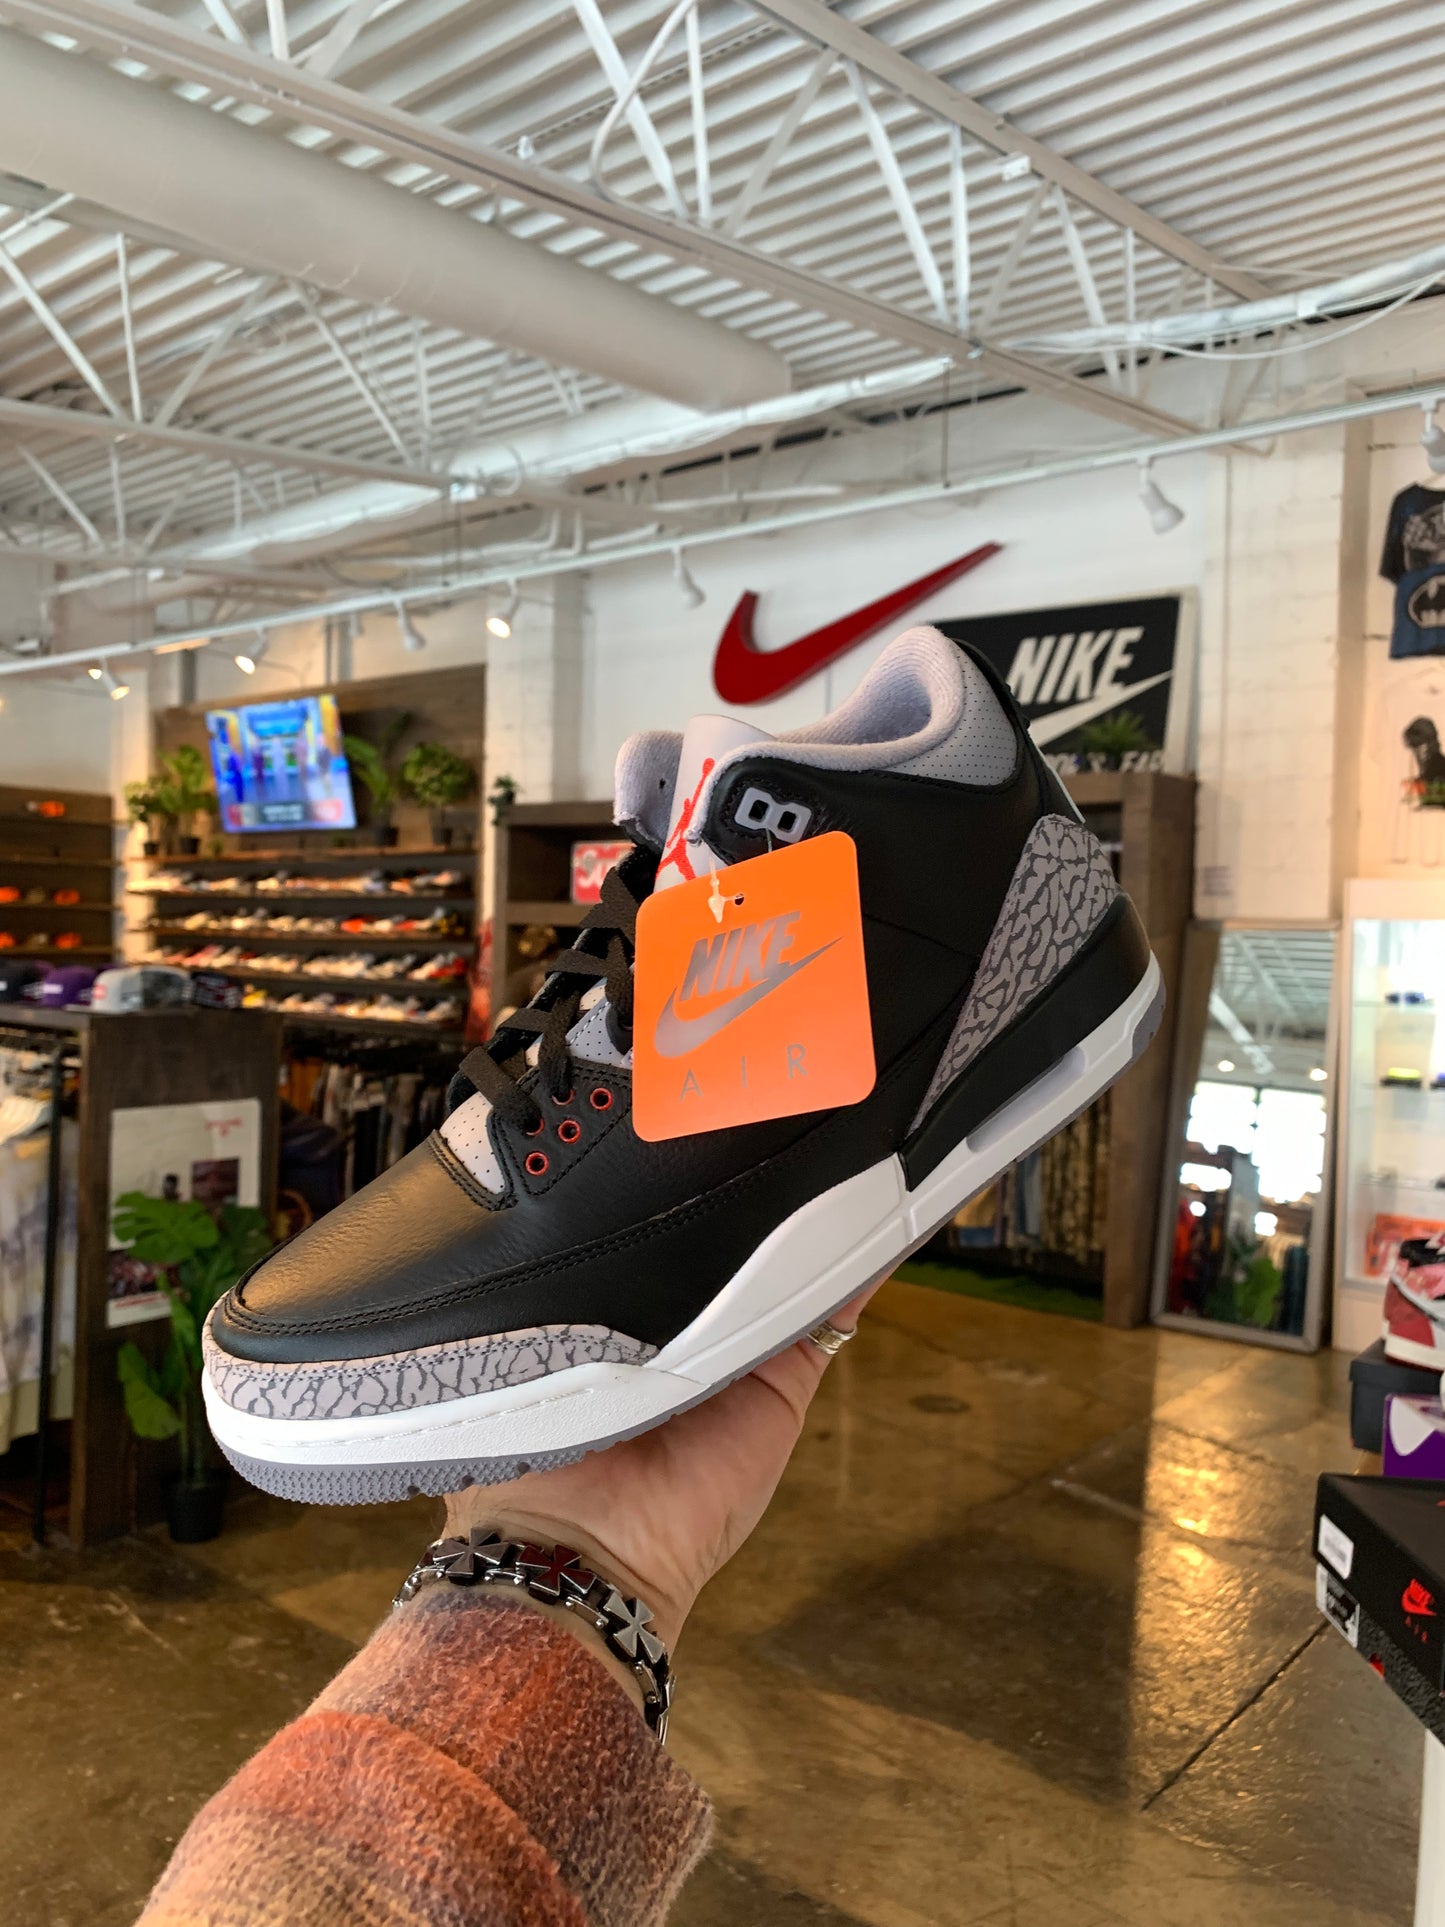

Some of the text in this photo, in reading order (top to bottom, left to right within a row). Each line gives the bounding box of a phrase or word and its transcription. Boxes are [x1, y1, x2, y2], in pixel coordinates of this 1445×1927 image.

[1006, 625, 1145, 707] NIKE
[678, 910, 802, 1002] NIKE
[678, 1043, 808, 1102] AIR
